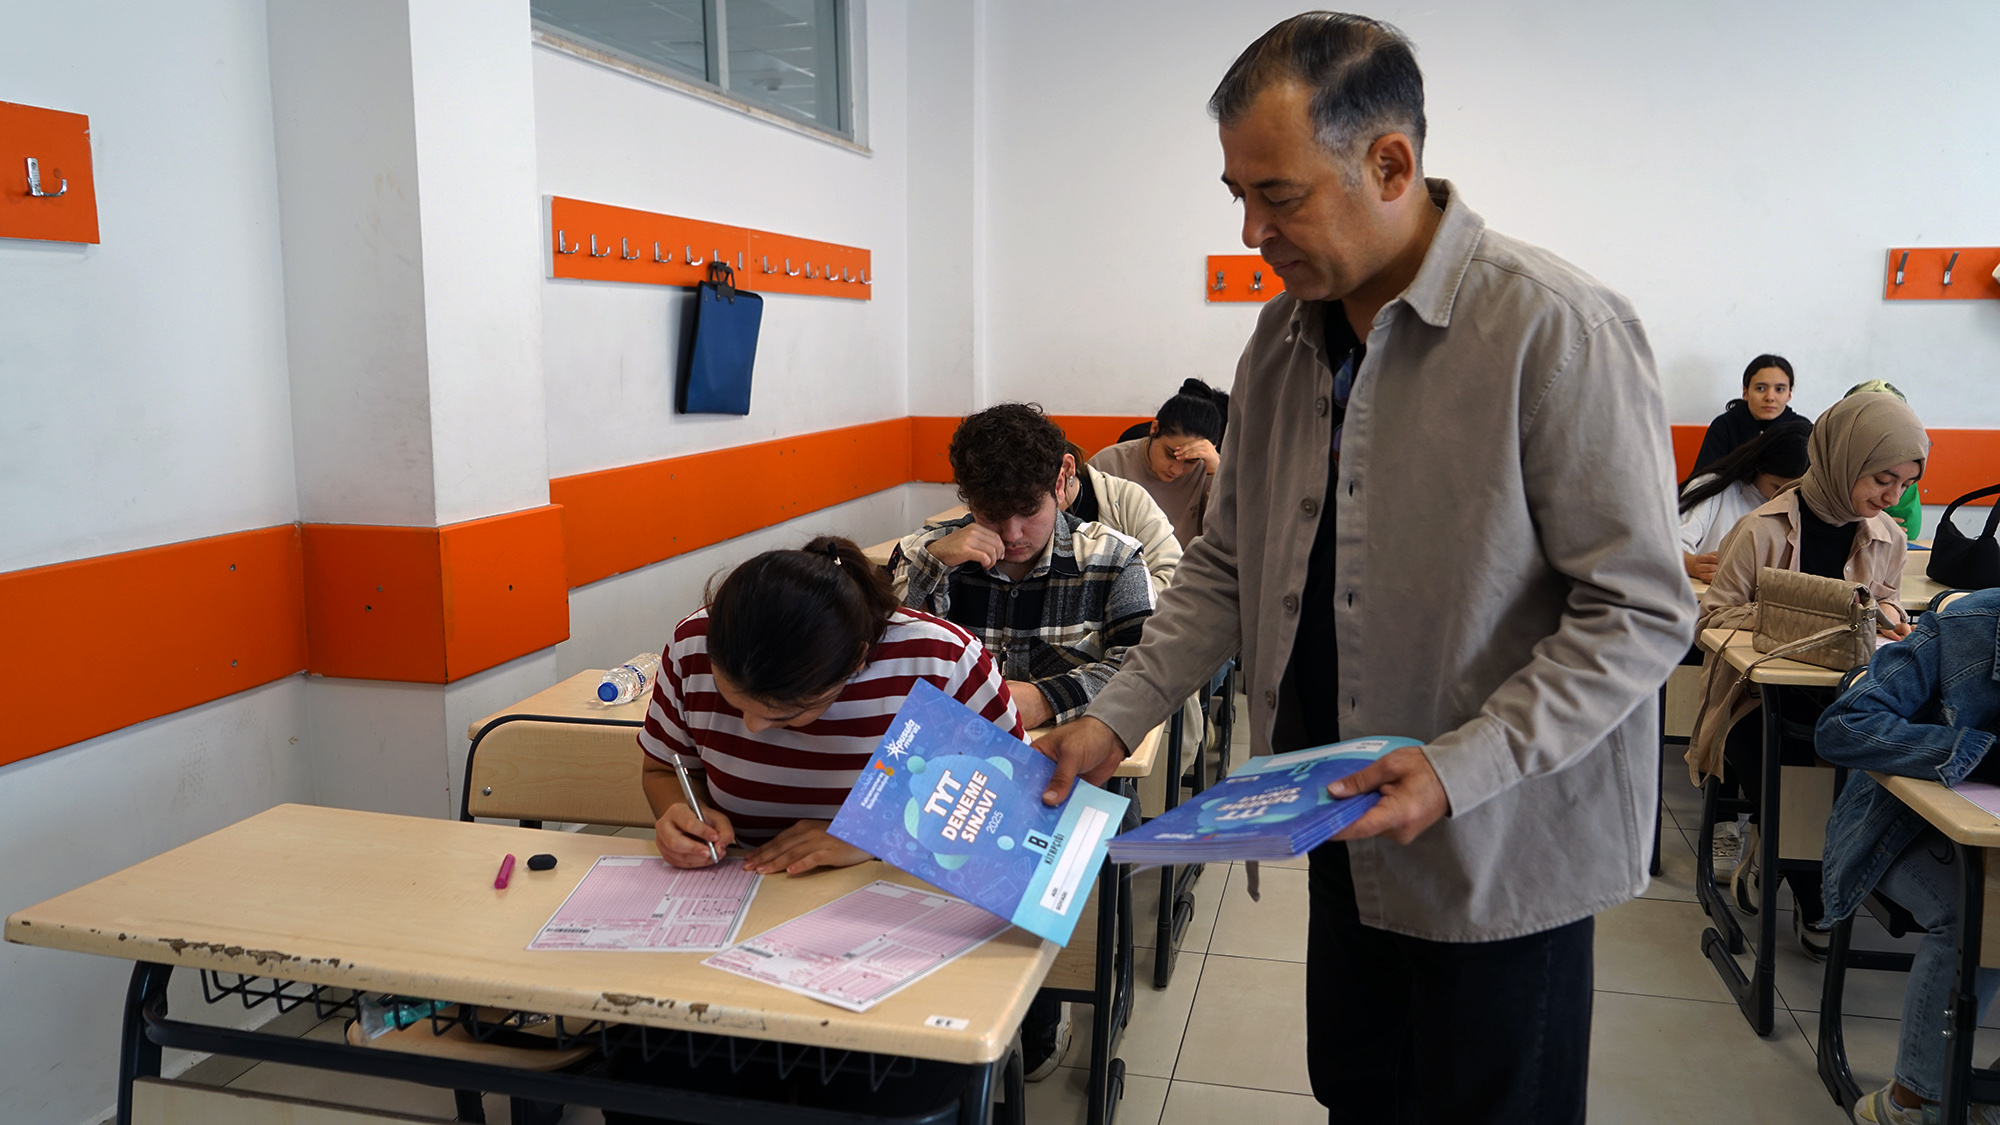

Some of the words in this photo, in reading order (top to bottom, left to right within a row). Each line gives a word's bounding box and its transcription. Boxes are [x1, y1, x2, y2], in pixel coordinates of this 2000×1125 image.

[897, 718, 915, 752] pusula
[923, 769, 963, 817] TYT
[941, 770, 988, 842] DENEME
[960, 789, 998, 844] SINAVI
[986, 810, 1004, 835] 2025
[1214, 805, 1269, 821] TYT
[1027, 835, 1049, 850] B
